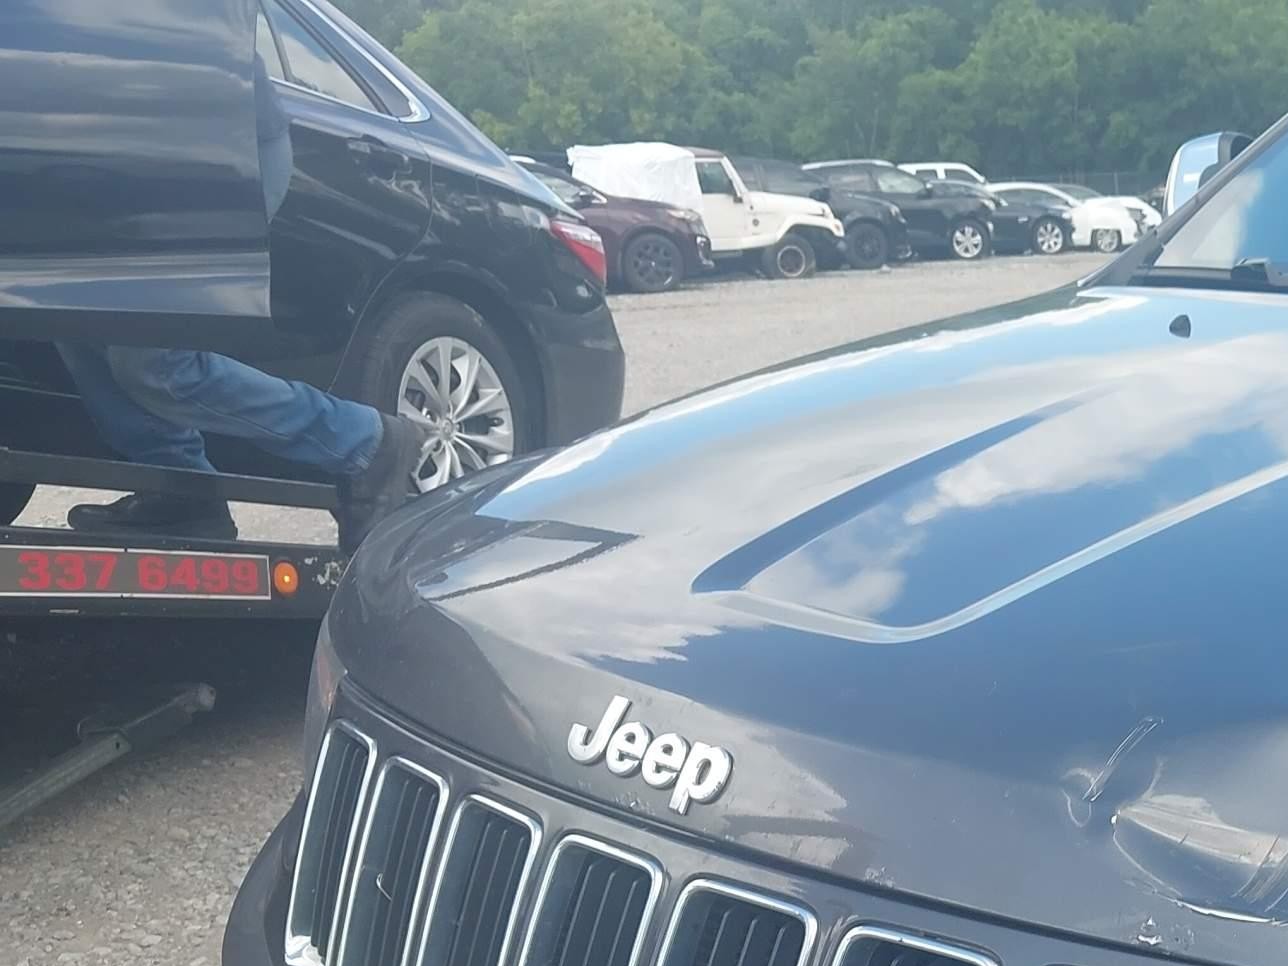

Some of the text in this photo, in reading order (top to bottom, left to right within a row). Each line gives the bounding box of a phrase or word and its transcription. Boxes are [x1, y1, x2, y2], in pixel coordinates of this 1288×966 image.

[18, 551, 259, 593] 337 6499
[567, 695, 733, 816] Jeep
